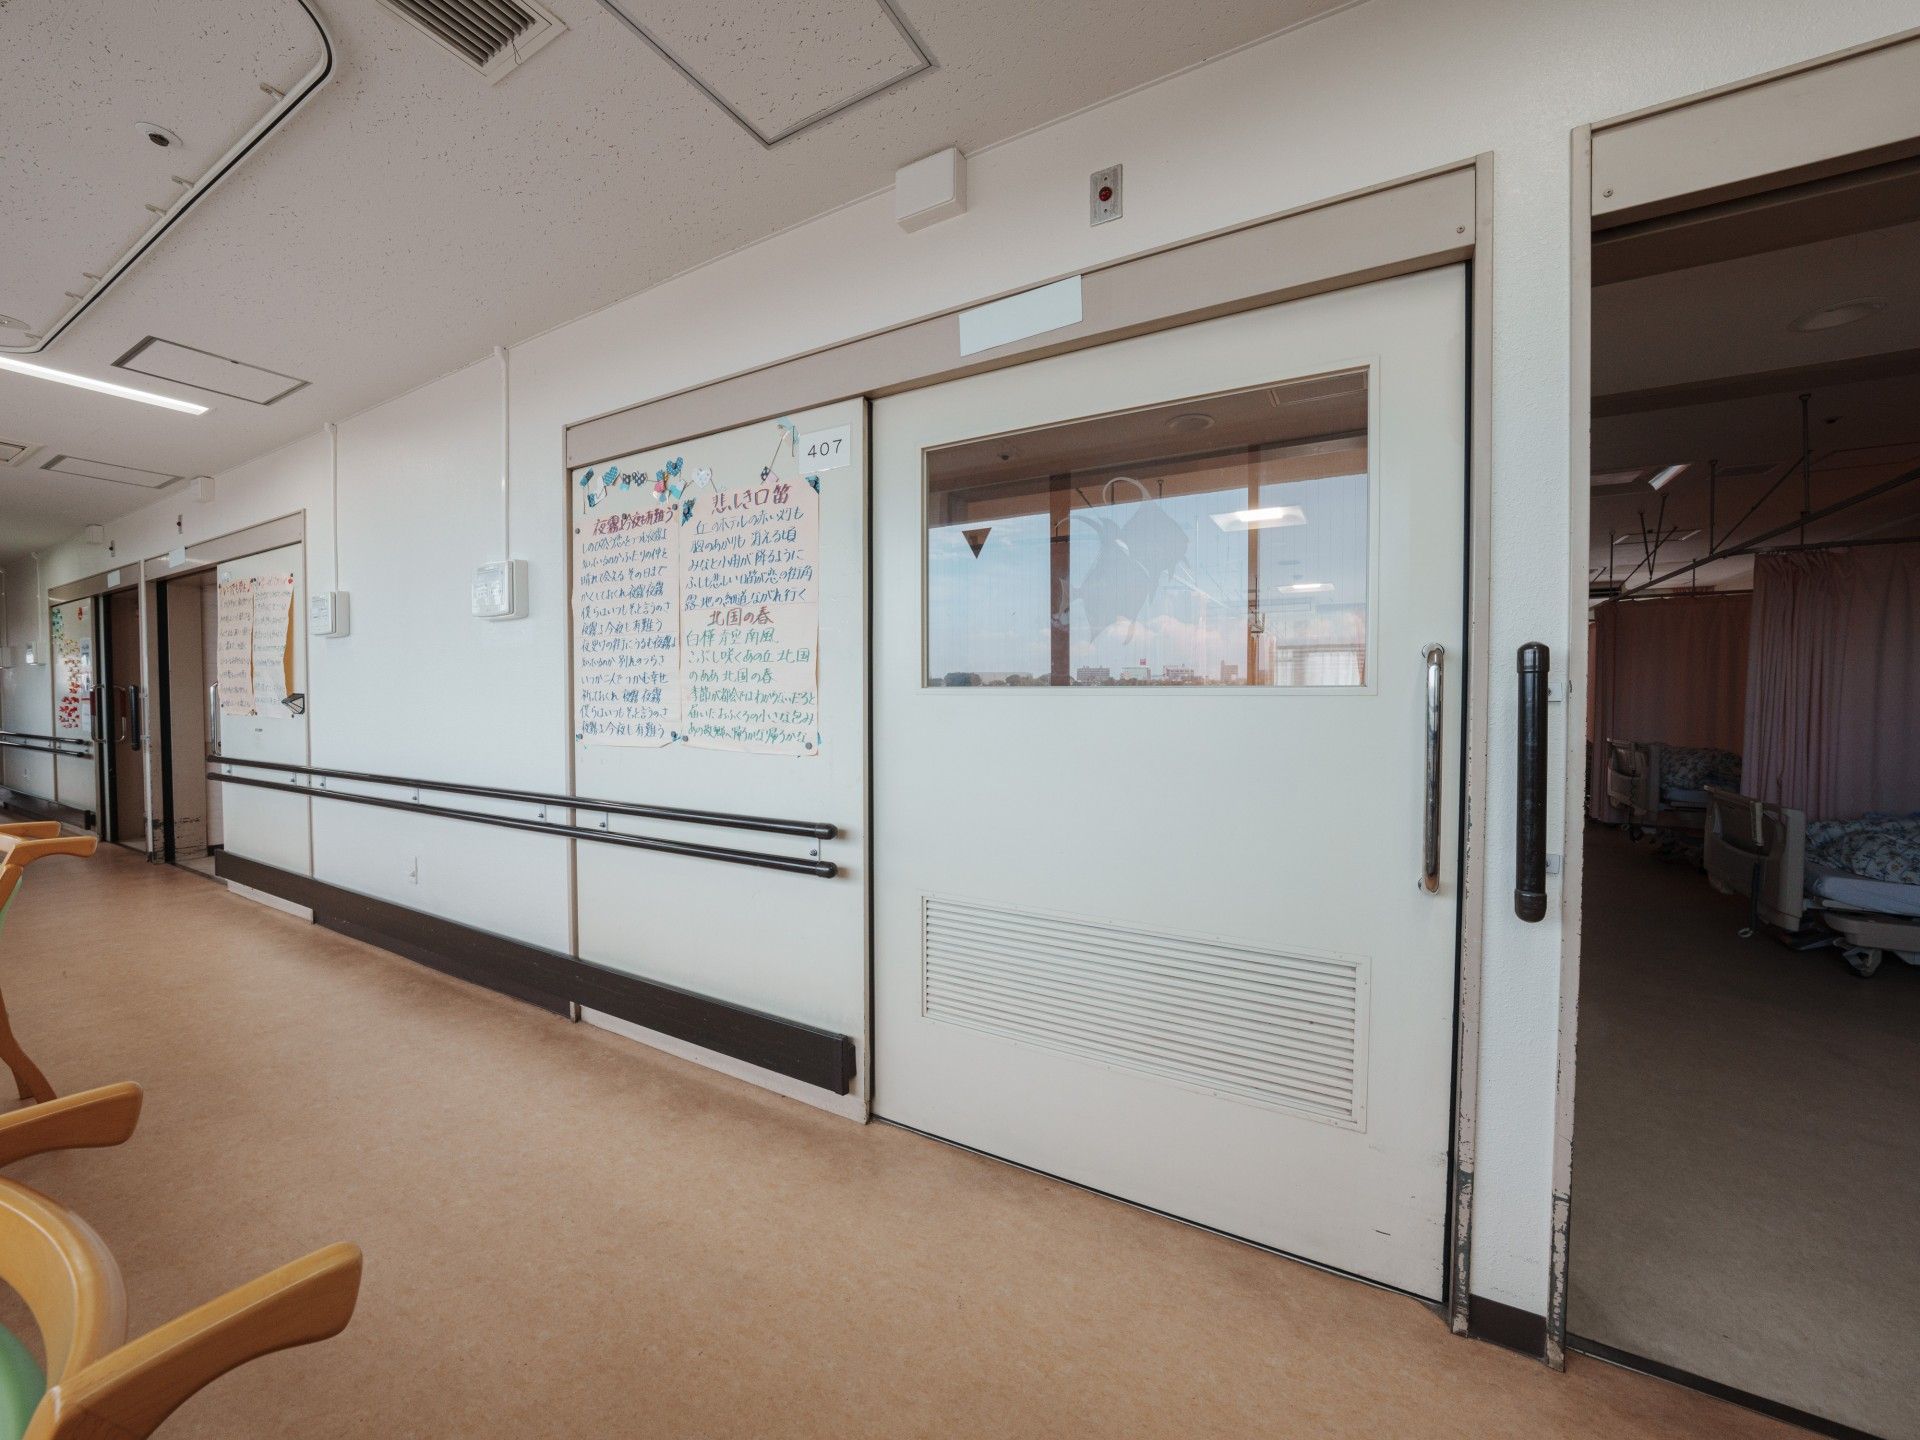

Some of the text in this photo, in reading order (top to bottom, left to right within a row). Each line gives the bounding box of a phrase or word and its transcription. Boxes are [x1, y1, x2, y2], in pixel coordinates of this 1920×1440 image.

[808, 439, 842, 458] 407
[711, 483, 792, 515] 悲しき口笛
[707, 605, 774, 626] 北国の春
